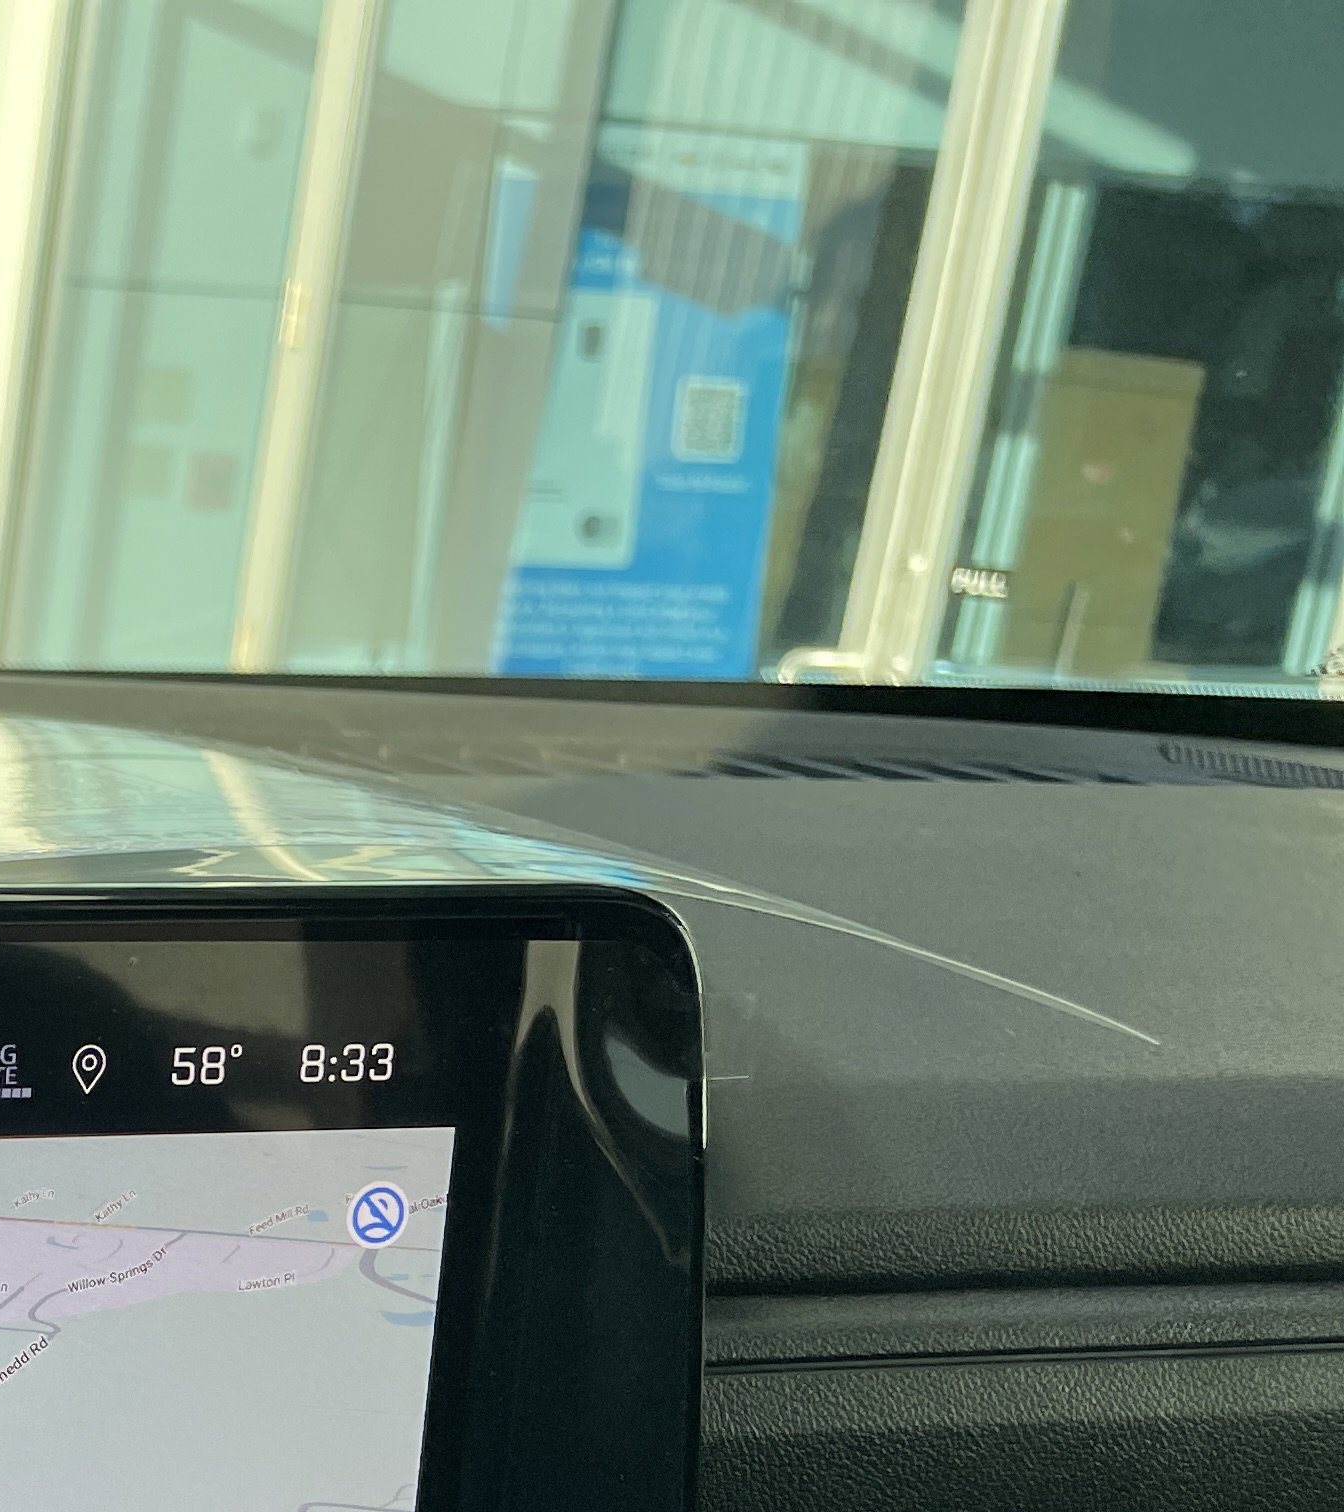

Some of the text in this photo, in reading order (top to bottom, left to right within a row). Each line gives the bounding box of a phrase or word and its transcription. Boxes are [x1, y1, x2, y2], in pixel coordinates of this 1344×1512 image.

[299, 1043, 395, 1083] 8:33
[14, 1188, 55, 1207] Kathy Ln
[95, 1188, 137, 1223] Kathy Ln
[249, 1204, 310, 1236] Feed Mill Rd
[67, 1247, 168, 1293] Willow Springs Dr
[238, 1273, 296, 1290] Lawton Pl
[28, 1336, 50, 1359] Rd
